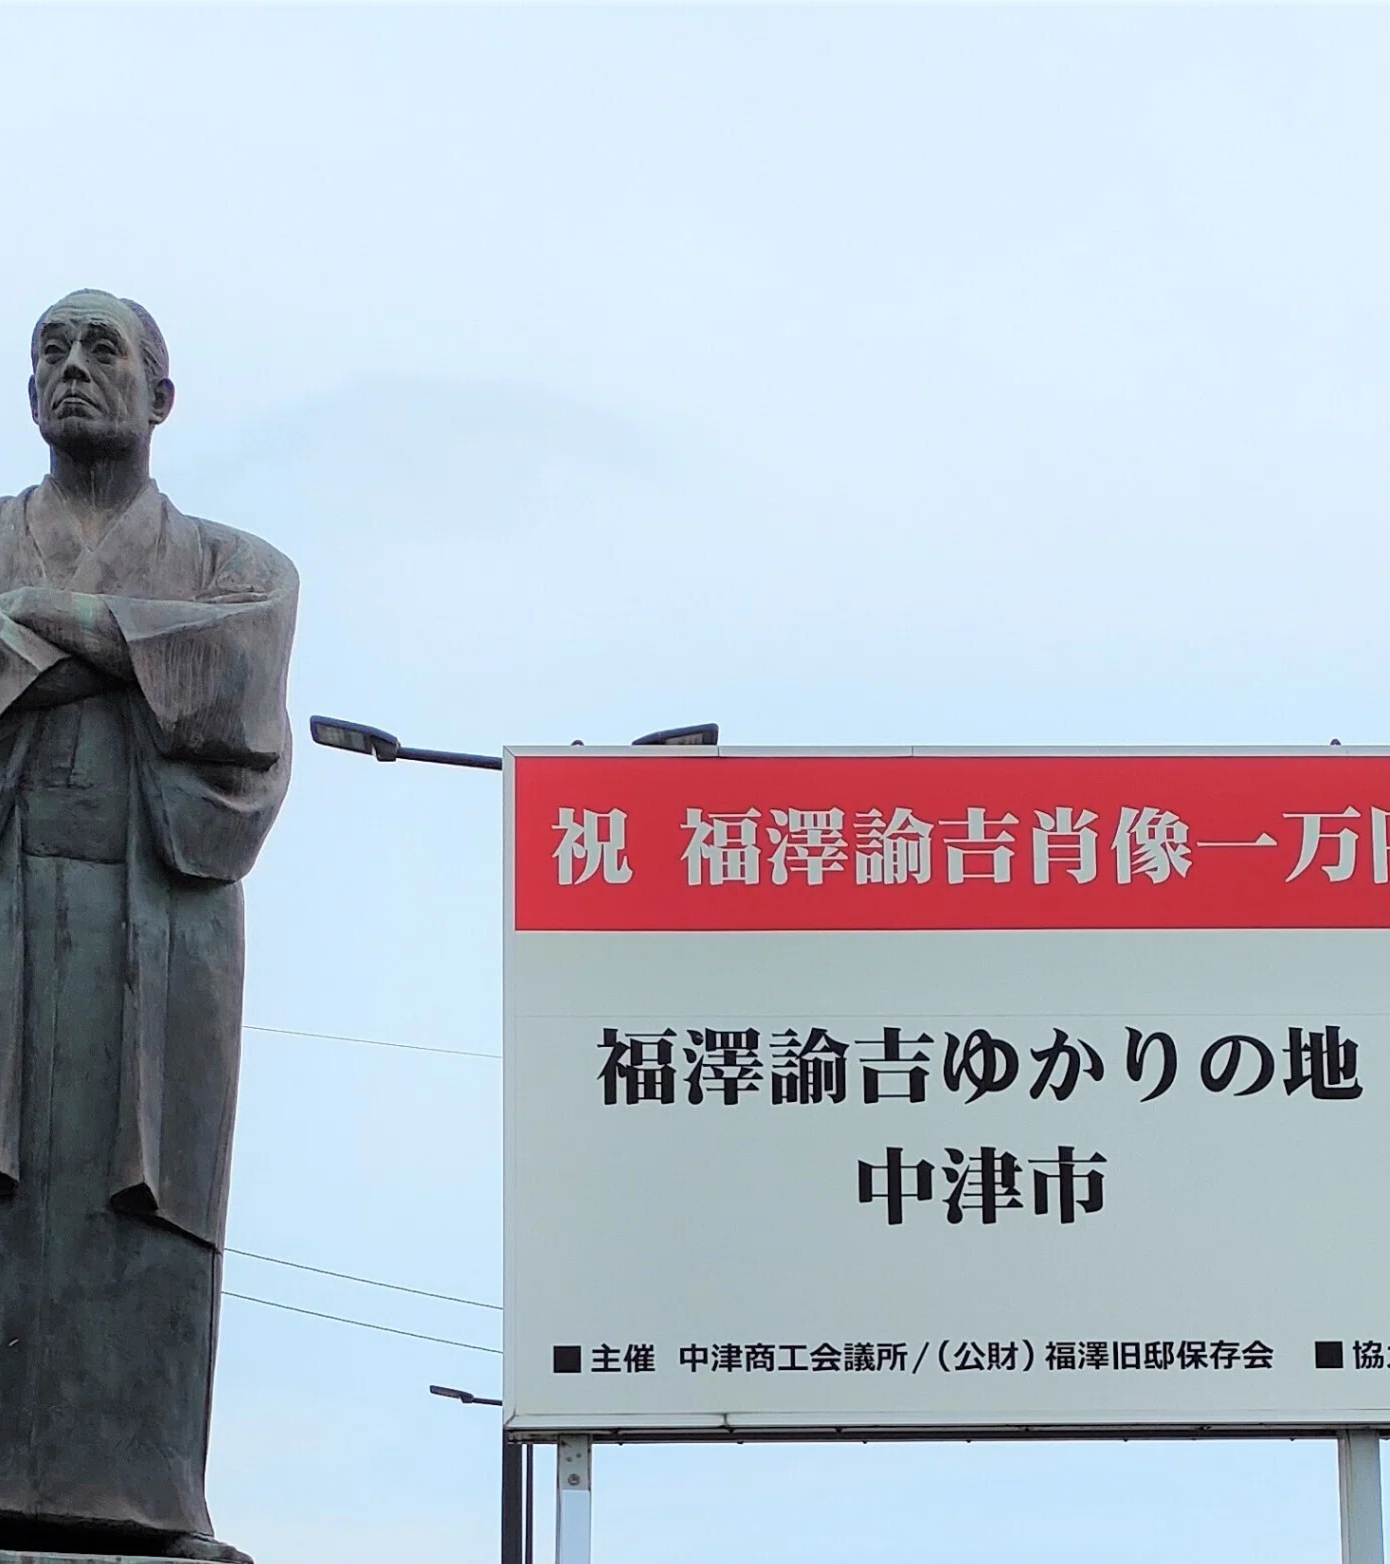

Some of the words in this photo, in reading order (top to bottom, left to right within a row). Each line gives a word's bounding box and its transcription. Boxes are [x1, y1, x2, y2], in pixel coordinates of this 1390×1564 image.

[551, 806, 635, 887] 祝
[596, 1026, 1365, 1107] 福澤諭吉ゆかりの地
[856, 1145, 1108, 1227] 中津市
